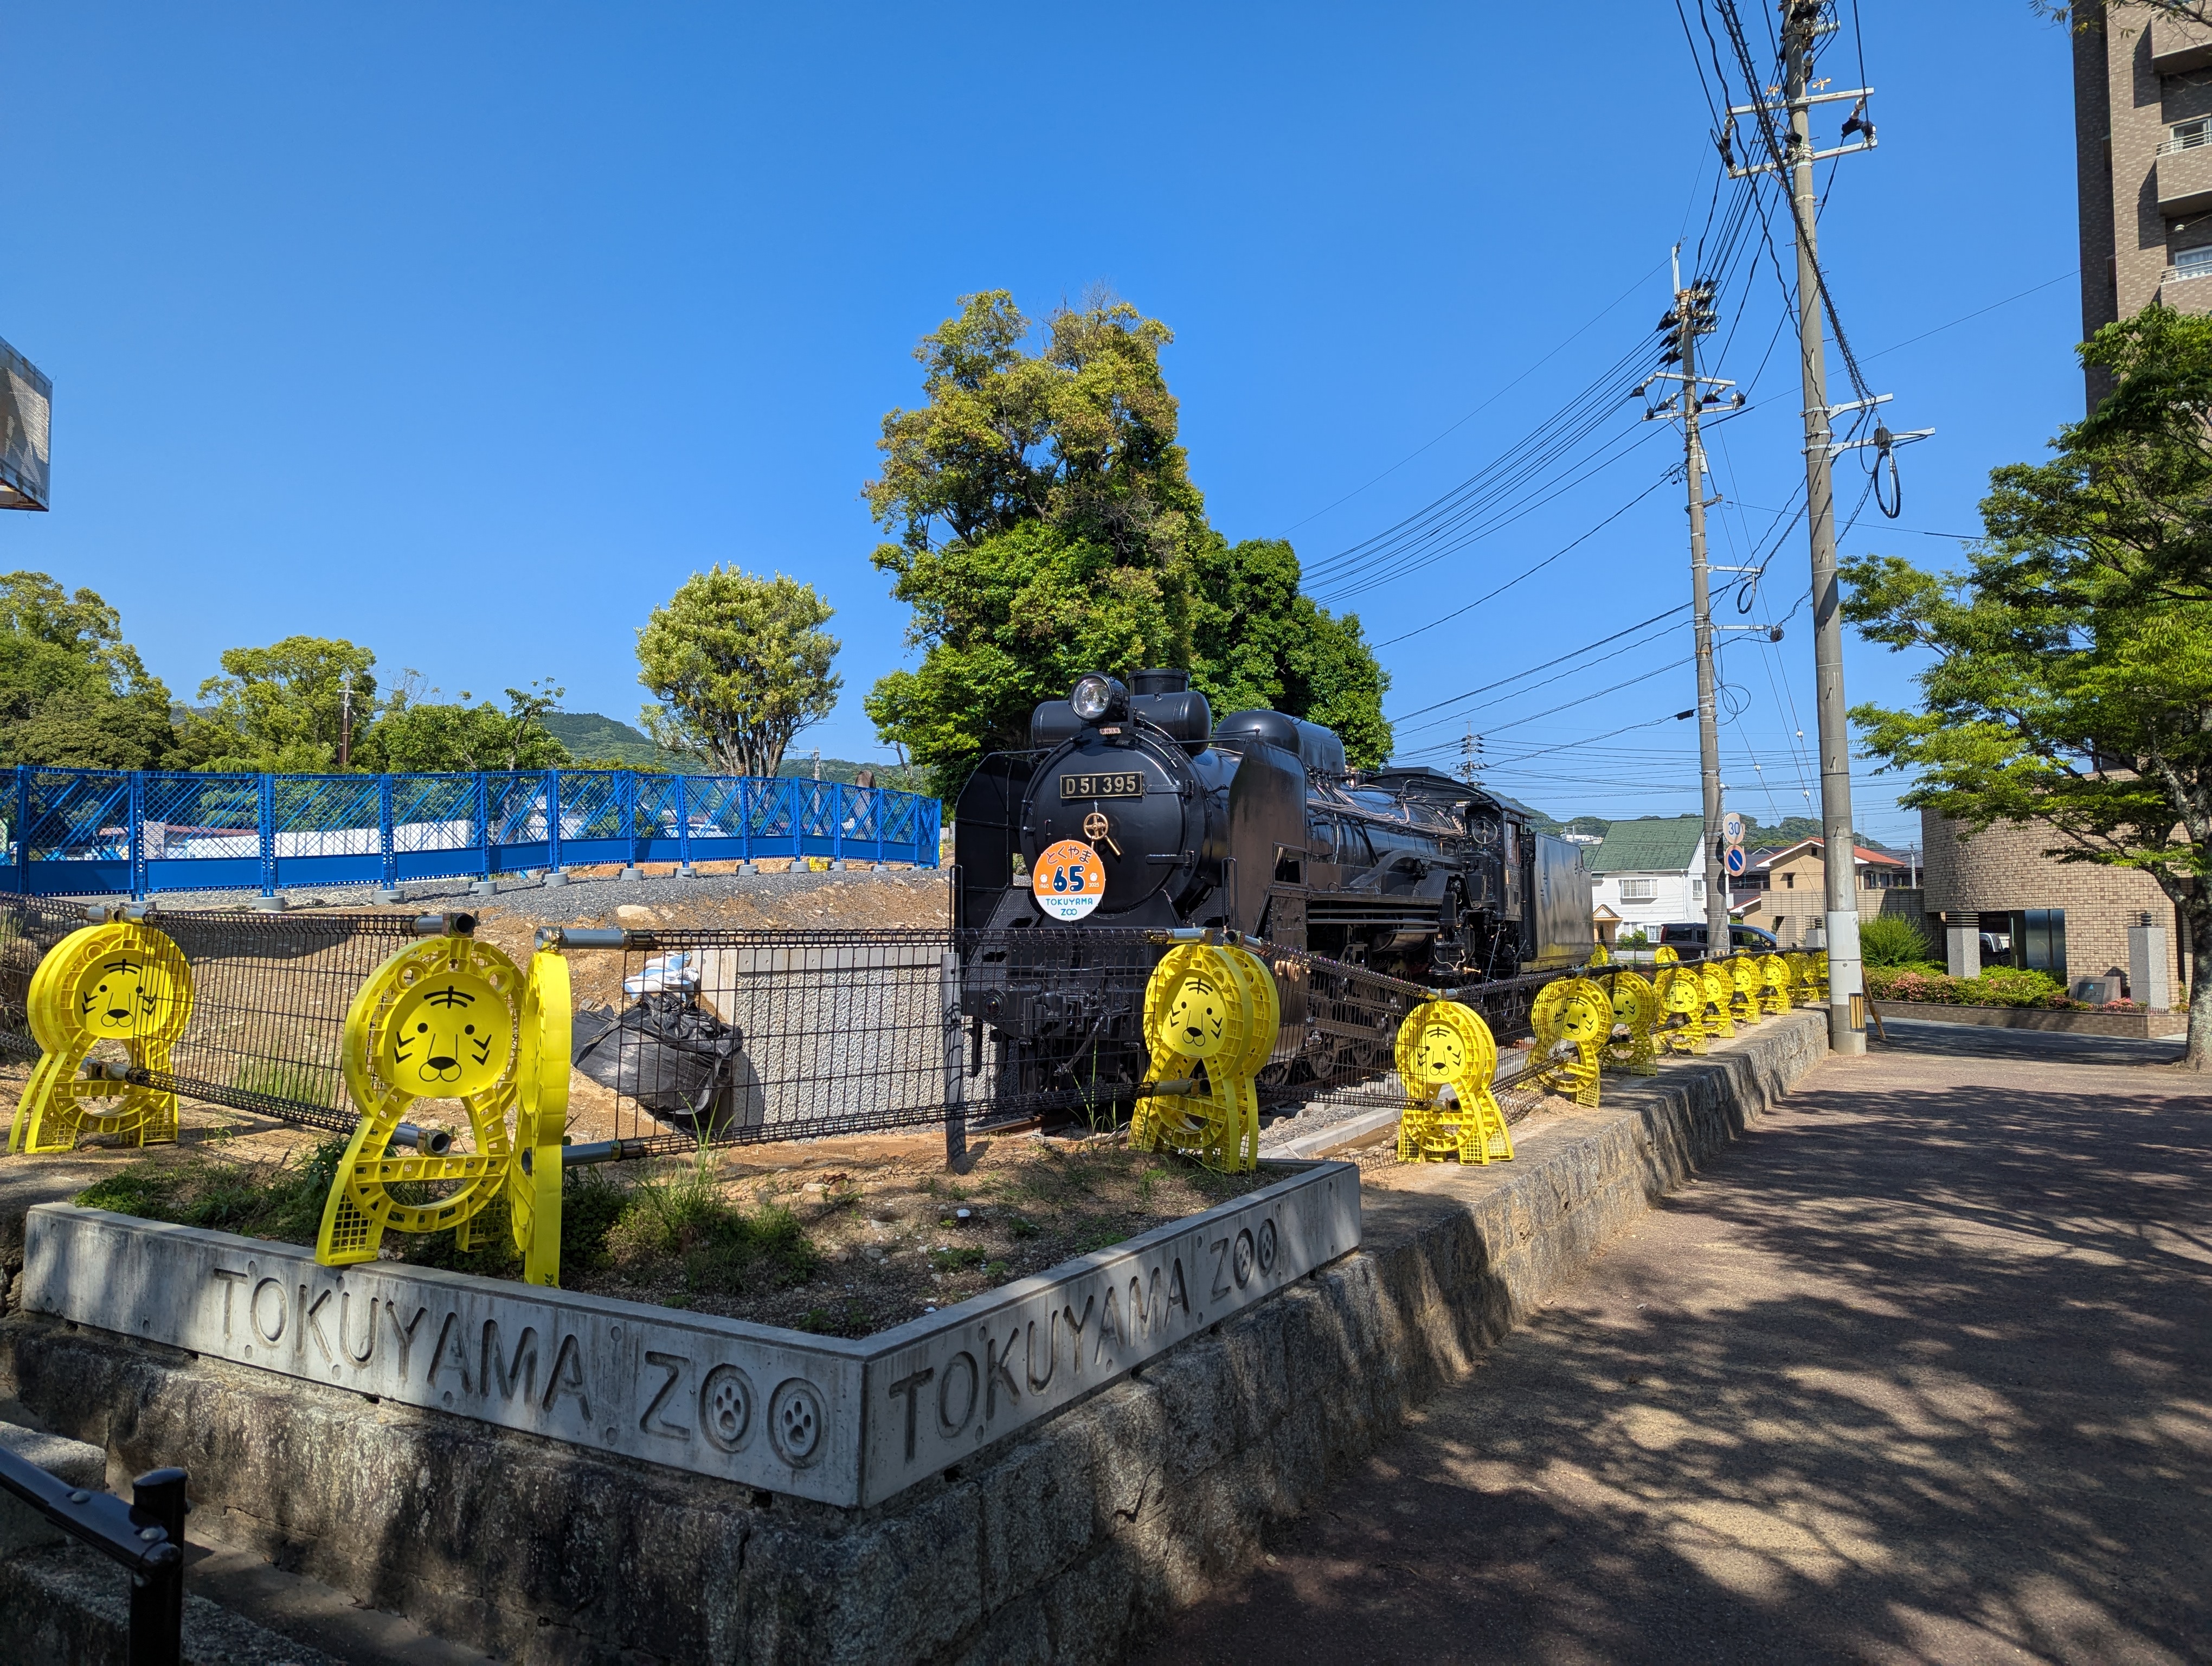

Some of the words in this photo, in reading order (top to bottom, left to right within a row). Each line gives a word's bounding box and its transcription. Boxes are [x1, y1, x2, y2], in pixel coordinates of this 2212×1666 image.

[1102, 776, 1136, 793] 395
[1728, 822, 1740, 835] 30
[1046, 844, 1093, 865] とくやま
[1052, 864, 1085, 893] 65
[1045, 898, 1093, 906] TOKUYAMA
[1060, 908, 1078, 916] ZOO
[889, 1257, 1190, 1464] TOKUYAMA
[1210, 1219, 1278, 1299] ZOO
[214, 1268, 593, 1421] TOKUYAMA
[640, 1350, 829, 1470] ZOO
